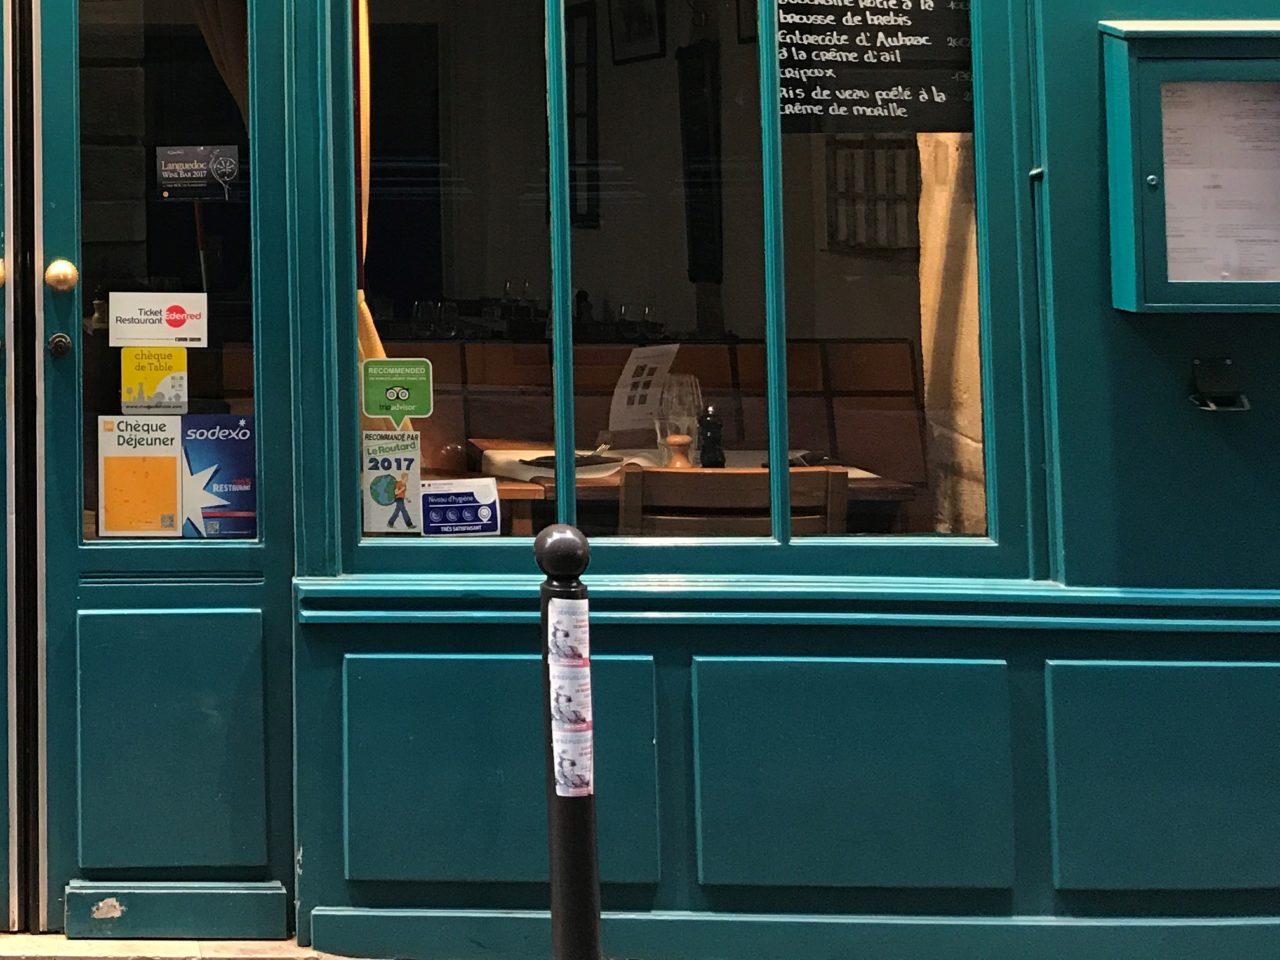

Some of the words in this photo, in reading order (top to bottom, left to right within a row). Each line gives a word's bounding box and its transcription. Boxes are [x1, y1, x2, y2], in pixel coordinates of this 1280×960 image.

[842, 11, 862, 26] de
[791, 46, 807, 60] la
[811, 85, 832, 100] de
[835, 88, 870, 100] veau
[918, 87, 929, 102] à
[930, 85, 947, 103] la
[828, 102, 849, 115] de
[161, 160, 208, 171] Languedoc
[115, 316, 163, 325] Restaurant
[138, 308, 163, 317] Ticket
[165, 311, 202, 320] Edenred
[134, 350, 173, 362] chèque
[134, 363, 146, 372] de
[148, 362, 173, 372] Table
[117, 420, 167, 434] Chèque
[185, 426, 250, 440] sodexo
[117, 435, 175, 448] Déjeuner
[368, 457, 415, 471] 2017
